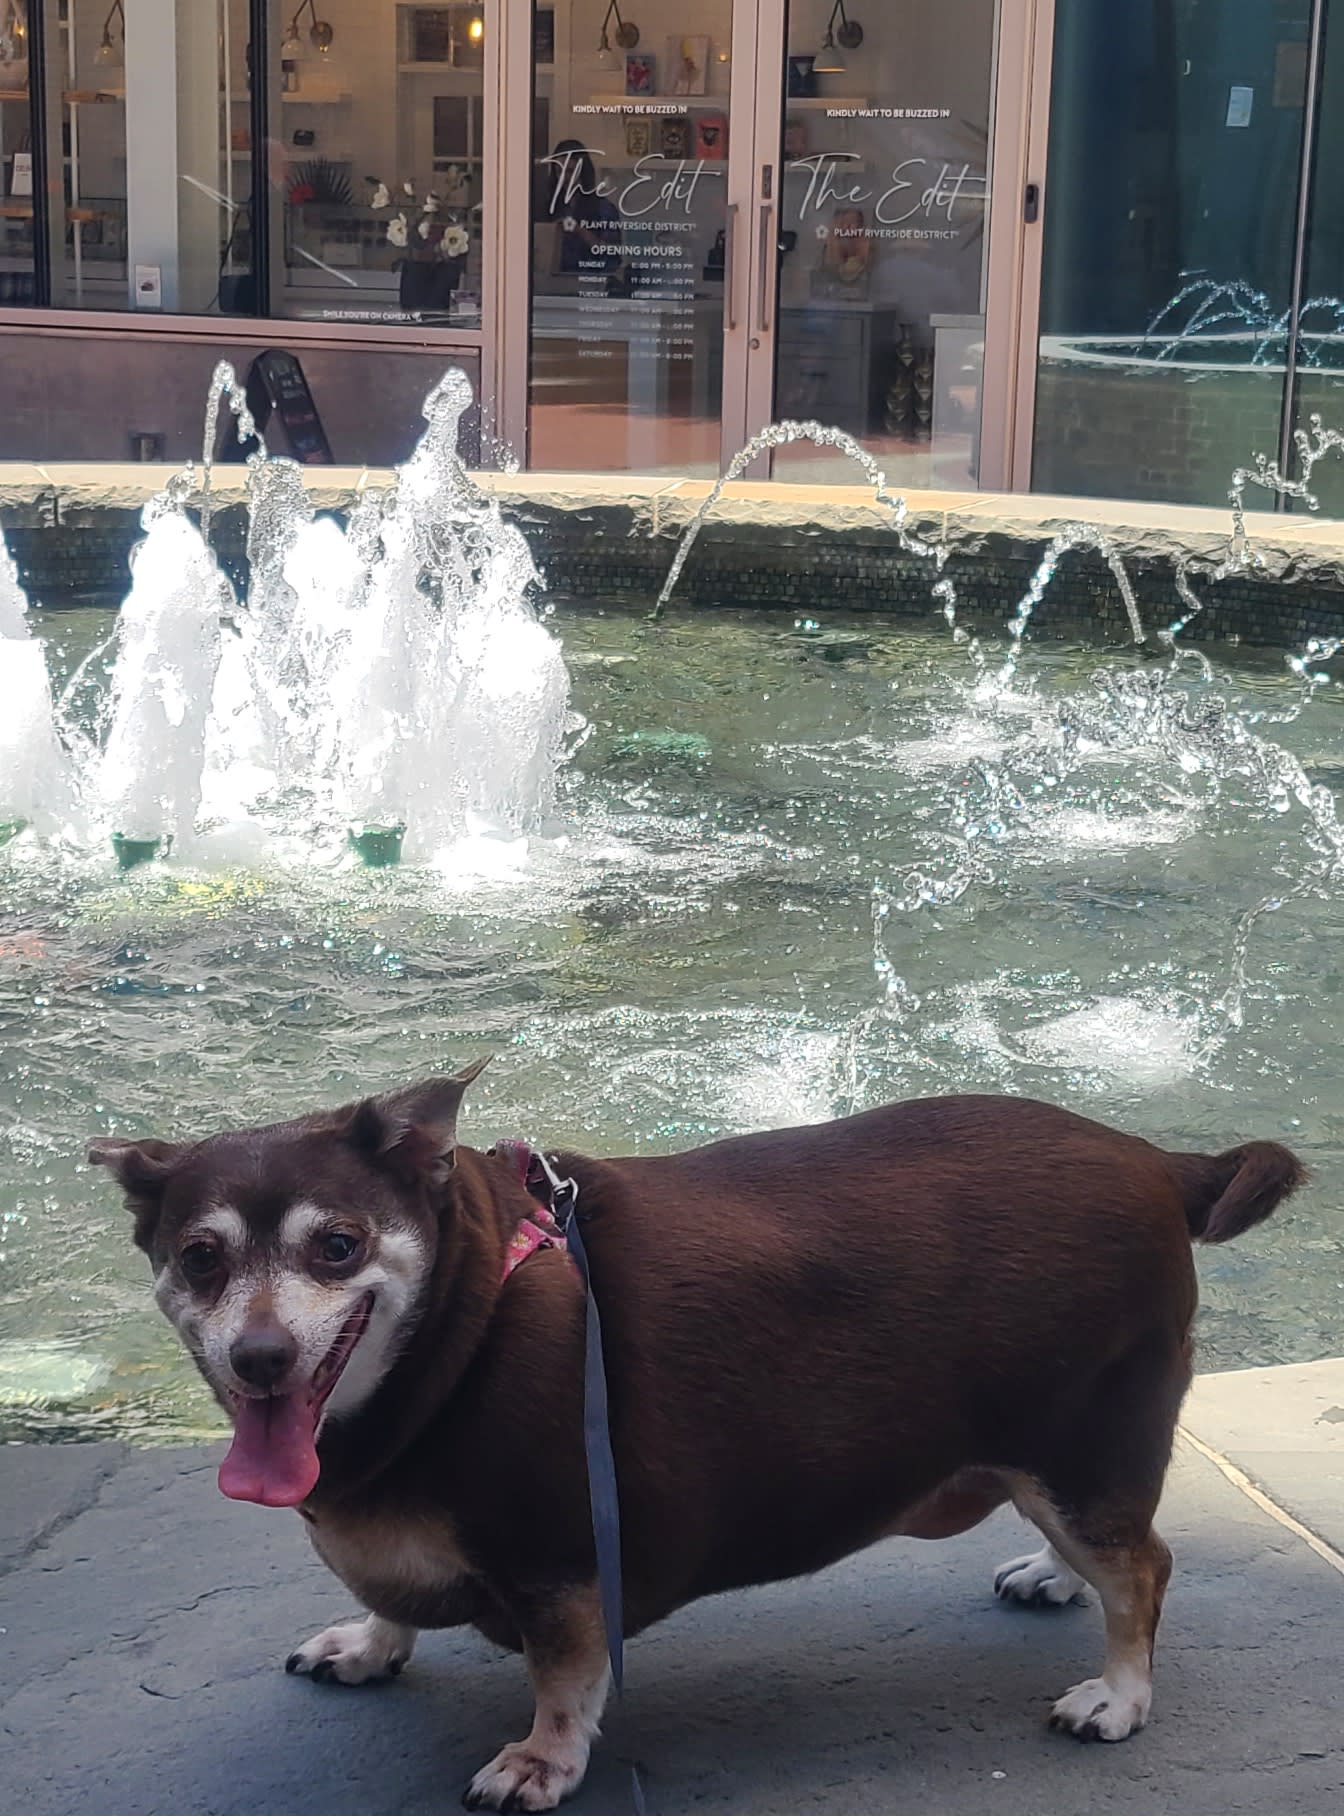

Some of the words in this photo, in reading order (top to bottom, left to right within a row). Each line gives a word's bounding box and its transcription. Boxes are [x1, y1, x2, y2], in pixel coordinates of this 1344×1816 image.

[573, 104, 600, 113] KINDLY
[602, 105, 622, 113] WAIT
[623, 105, 634, 114] TO
[635, 105, 645, 114] BE
[646, 105, 677, 114] BUZZED
[678, 105, 688, 114] IN
[826, 109, 857, 118] KINDLY
[858, 109, 879, 118] WAIT
[880, 109, 892, 118] TO
[893, 109, 904, 118] BE
[905, 109, 938, 118] BUZZED
[939, 109, 950, 118] IN
[540, 149, 617, 215] The
[619, 153, 721, 217] Edit
[790, 152, 872, 221] The
[875, 158, 986, 225] Edit
[580, 220, 608, 230] PLANT
[609, 220, 653, 231] RIVERSIDE
[834, 228, 863, 238] PLANT
[865, 229, 912, 238] RIVERSIDE
[591, 244, 641, 256] OPENING
[643, 246, 683, 257] HOURS
[382, 312, 412, 320] CAMERA
